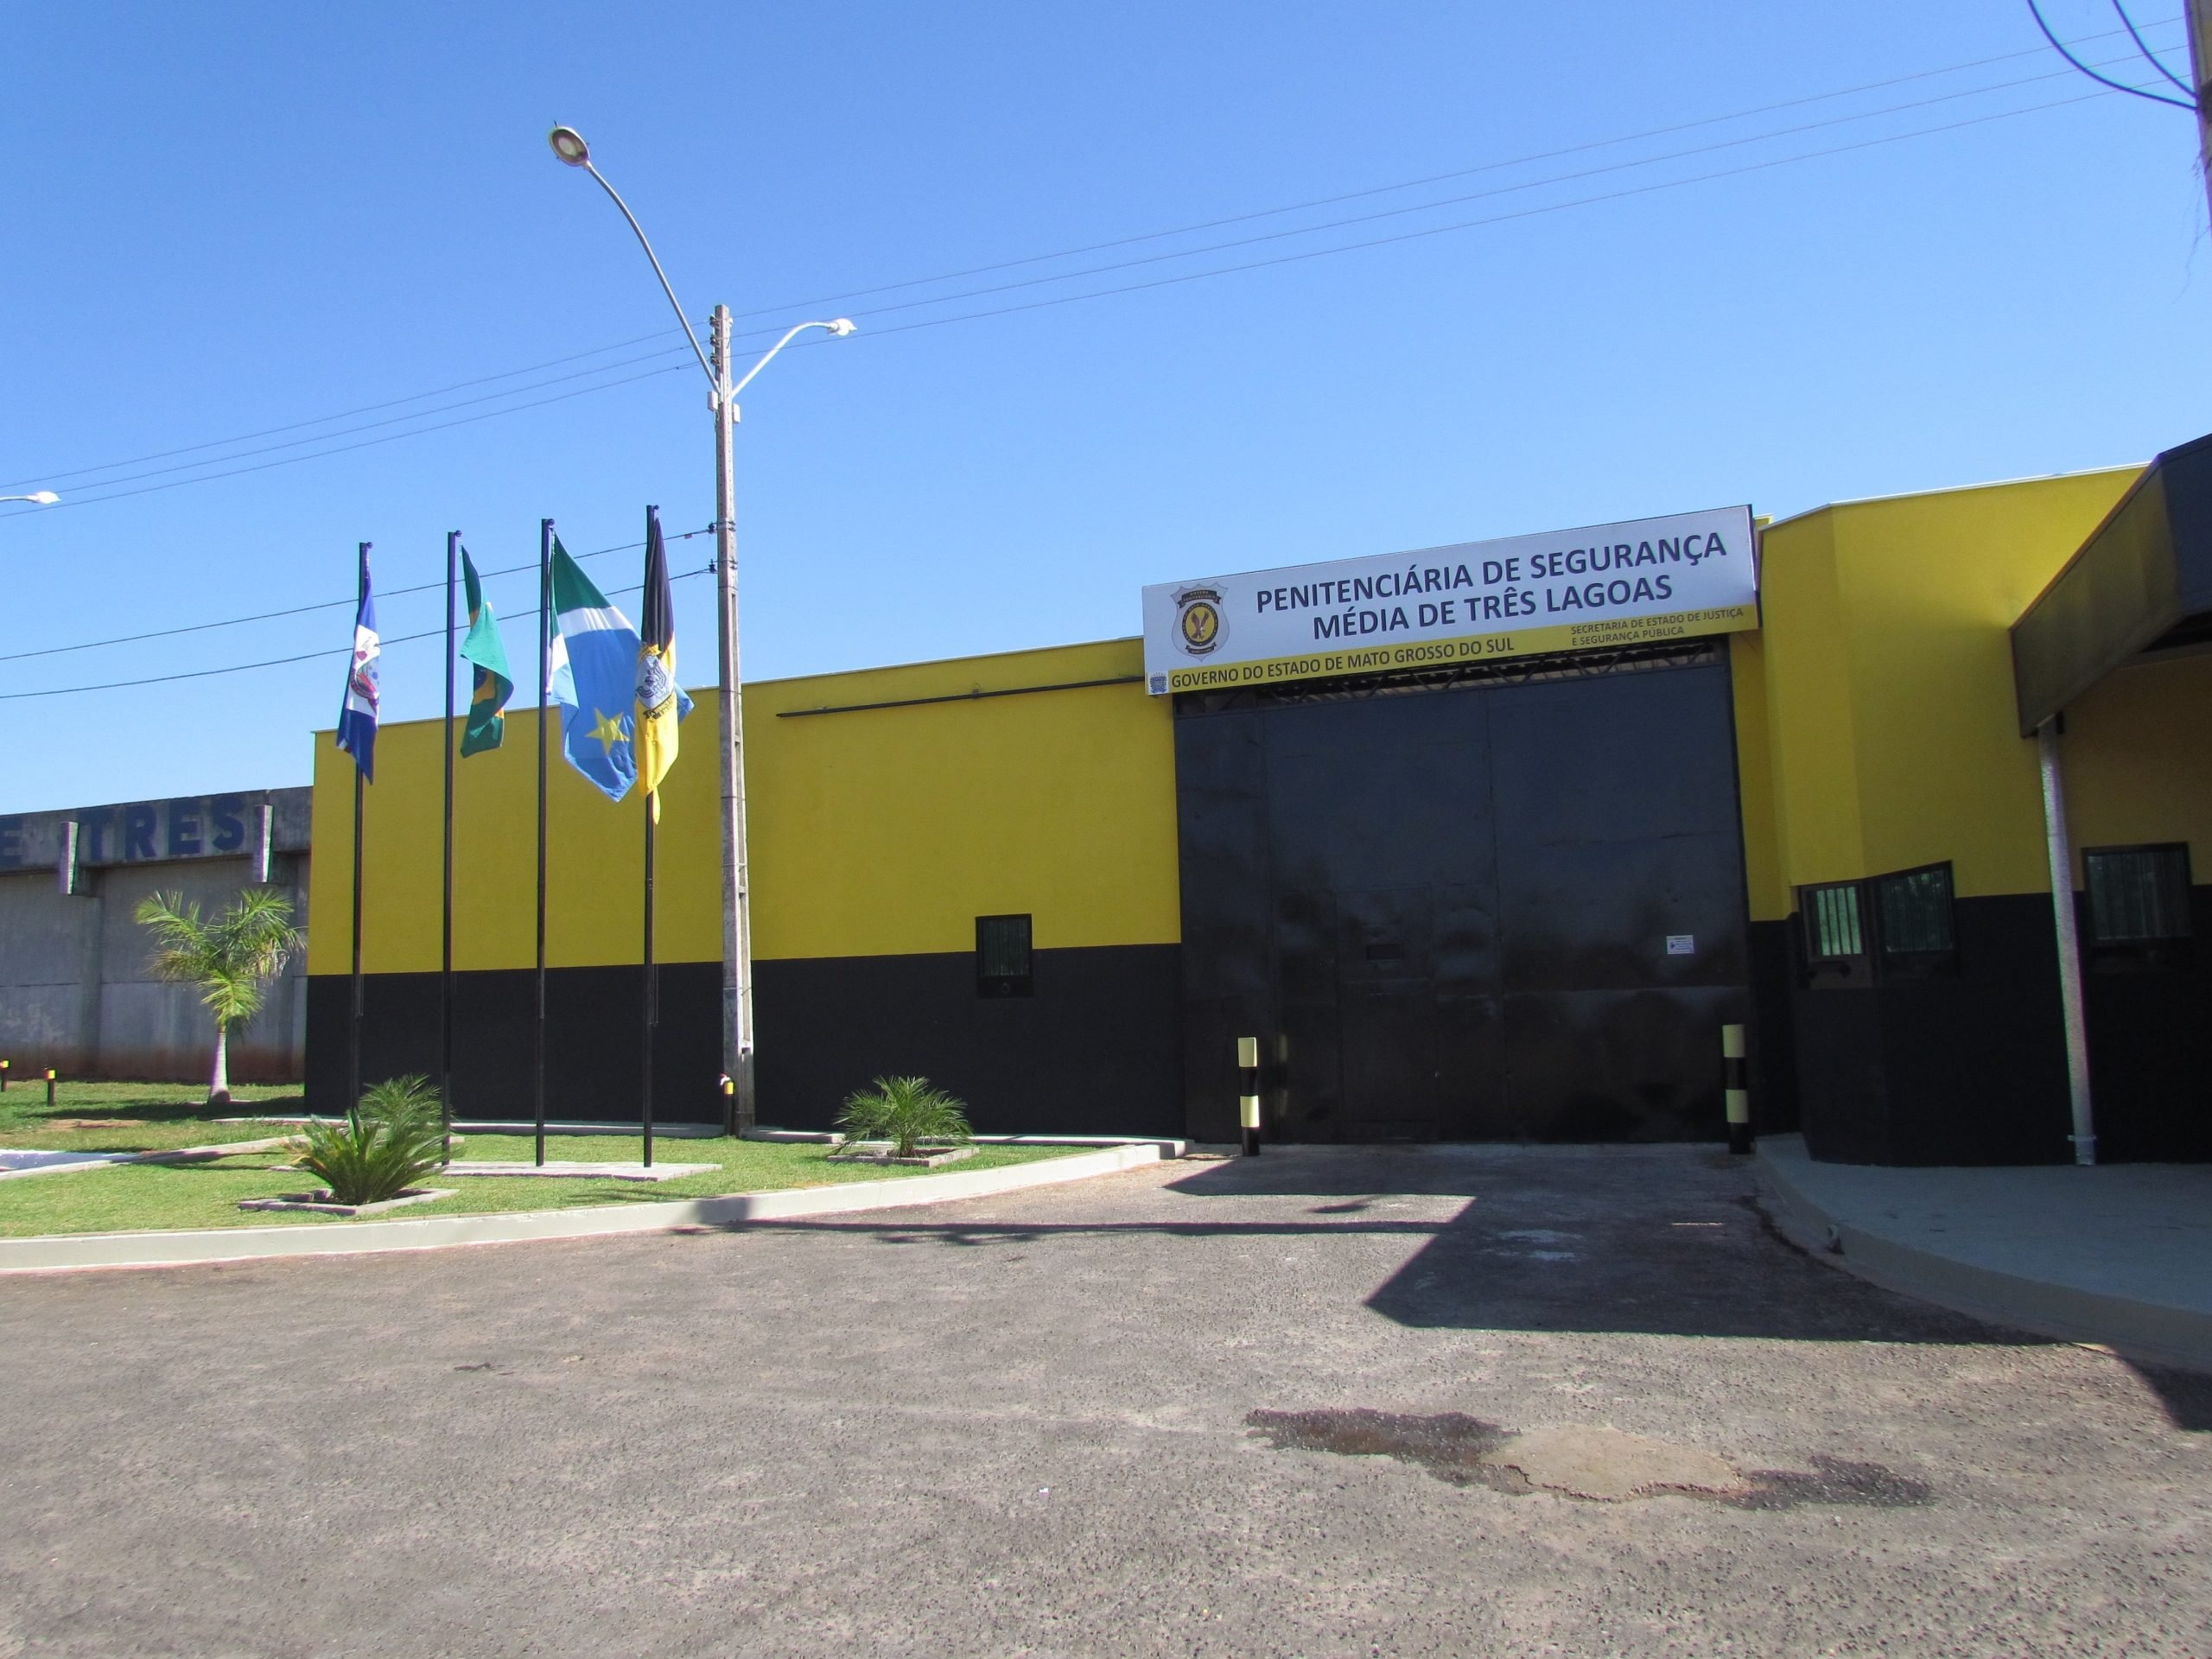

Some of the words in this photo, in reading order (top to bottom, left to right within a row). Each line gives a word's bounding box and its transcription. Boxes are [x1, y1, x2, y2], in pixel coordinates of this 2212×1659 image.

[1257, 564, 1472, 613] PENITENCIÁRIA
[1483, 558, 1520, 584] DE
[1530, 532, 1726, 579] SEGURANÇA
[1313, 607, 1409, 639] MÉDIA
[1419, 601, 1455, 627] DE
[1464, 587, 1535, 621] TRÊS
[1547, 575, 1672, 613] LAGOAS
[1571, 622, 1628, 635] SECRETARIA
[1631, 620, 1643, 628] DE
[1647, 614, 1684, 626] ESTADO
[1688, 613, 1700, 621] DE
[1702, 608, 1744, 620] JUSTIÇA
[1580, 632, 1639, 645] SEGURANÇA
[1643, 626, 1684, 639] PÚBLICA
[1172, 668, 1239, 688] GOVERNO
[1243, 666, 1263, 679] DO
[1268, 659, 1320, 677] ESTADO
[1325, 657, 1343, 671] DE
[1347, 651, 1390, 668] MATO
[1395, 644, 1455, 663] GROSSO
[1460, 641, 1482, 657] DO
[1486, 638, 1515, 653] SUL
